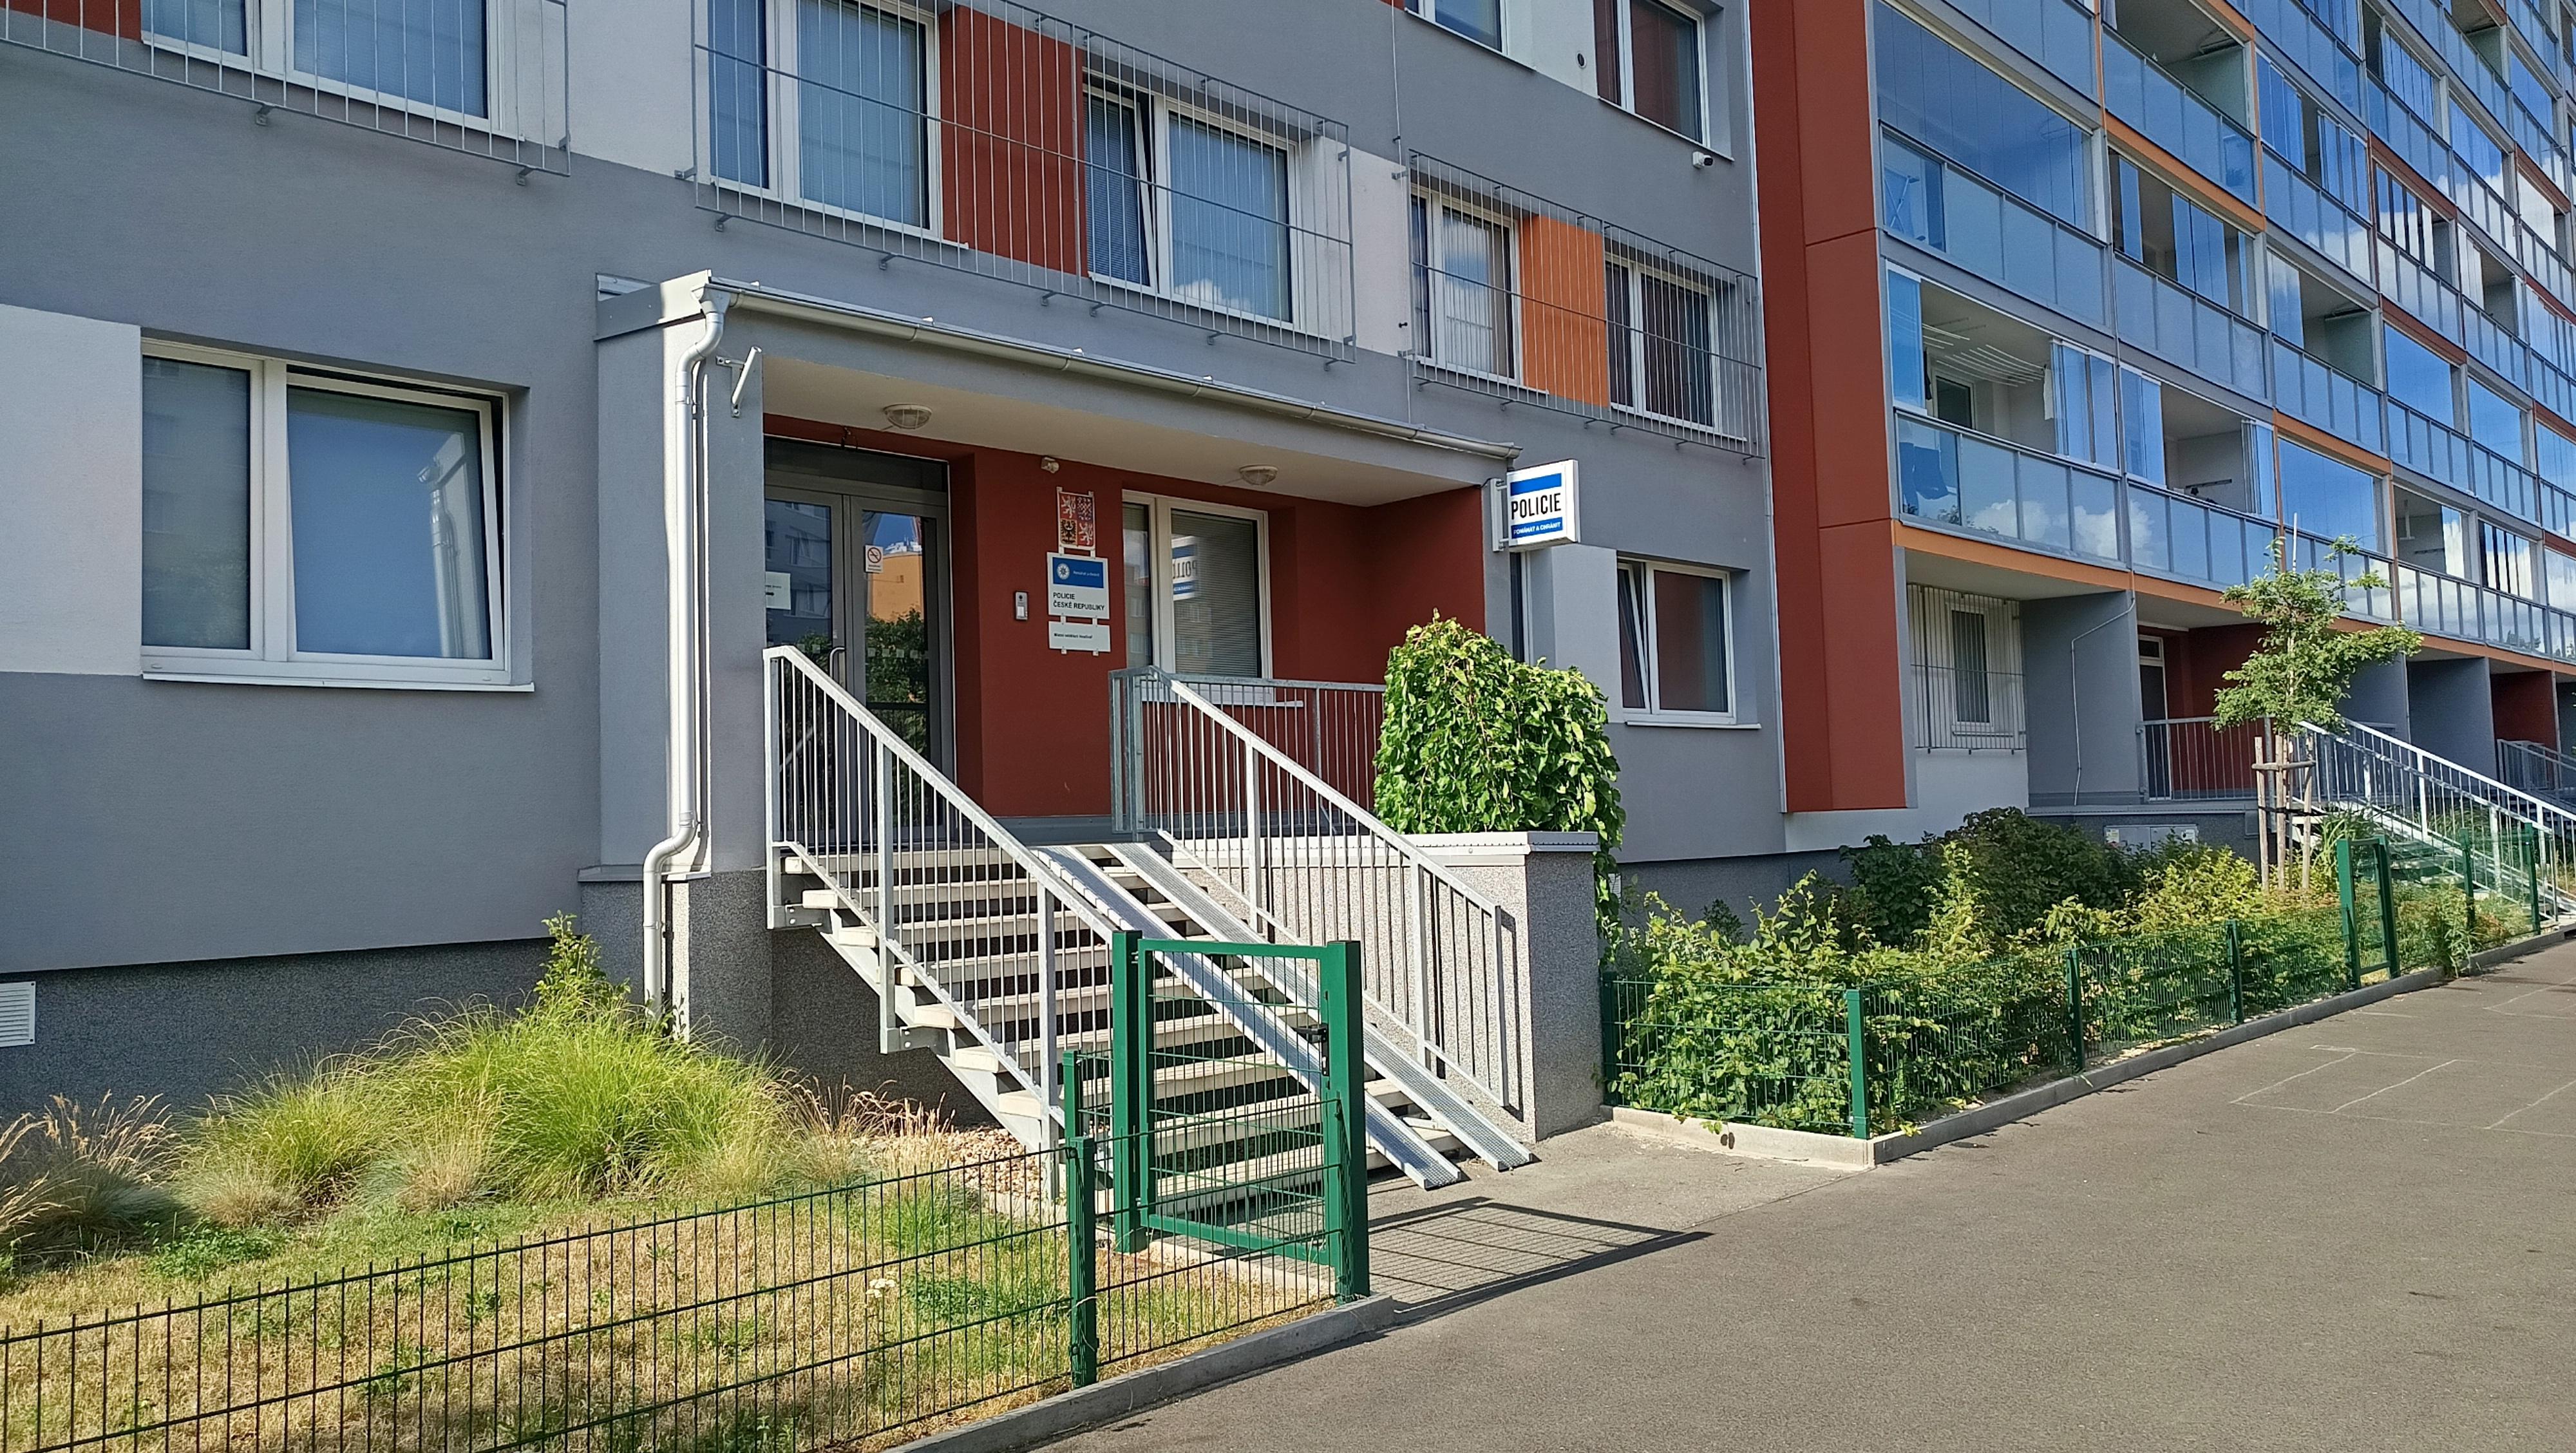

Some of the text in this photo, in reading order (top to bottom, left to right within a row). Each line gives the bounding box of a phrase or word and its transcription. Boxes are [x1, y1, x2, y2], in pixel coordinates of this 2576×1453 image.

[1511, 493, 1561, 520] POLICIE
[1053, 600, 1104, 611] ČESKÉ REPUBLIKY
